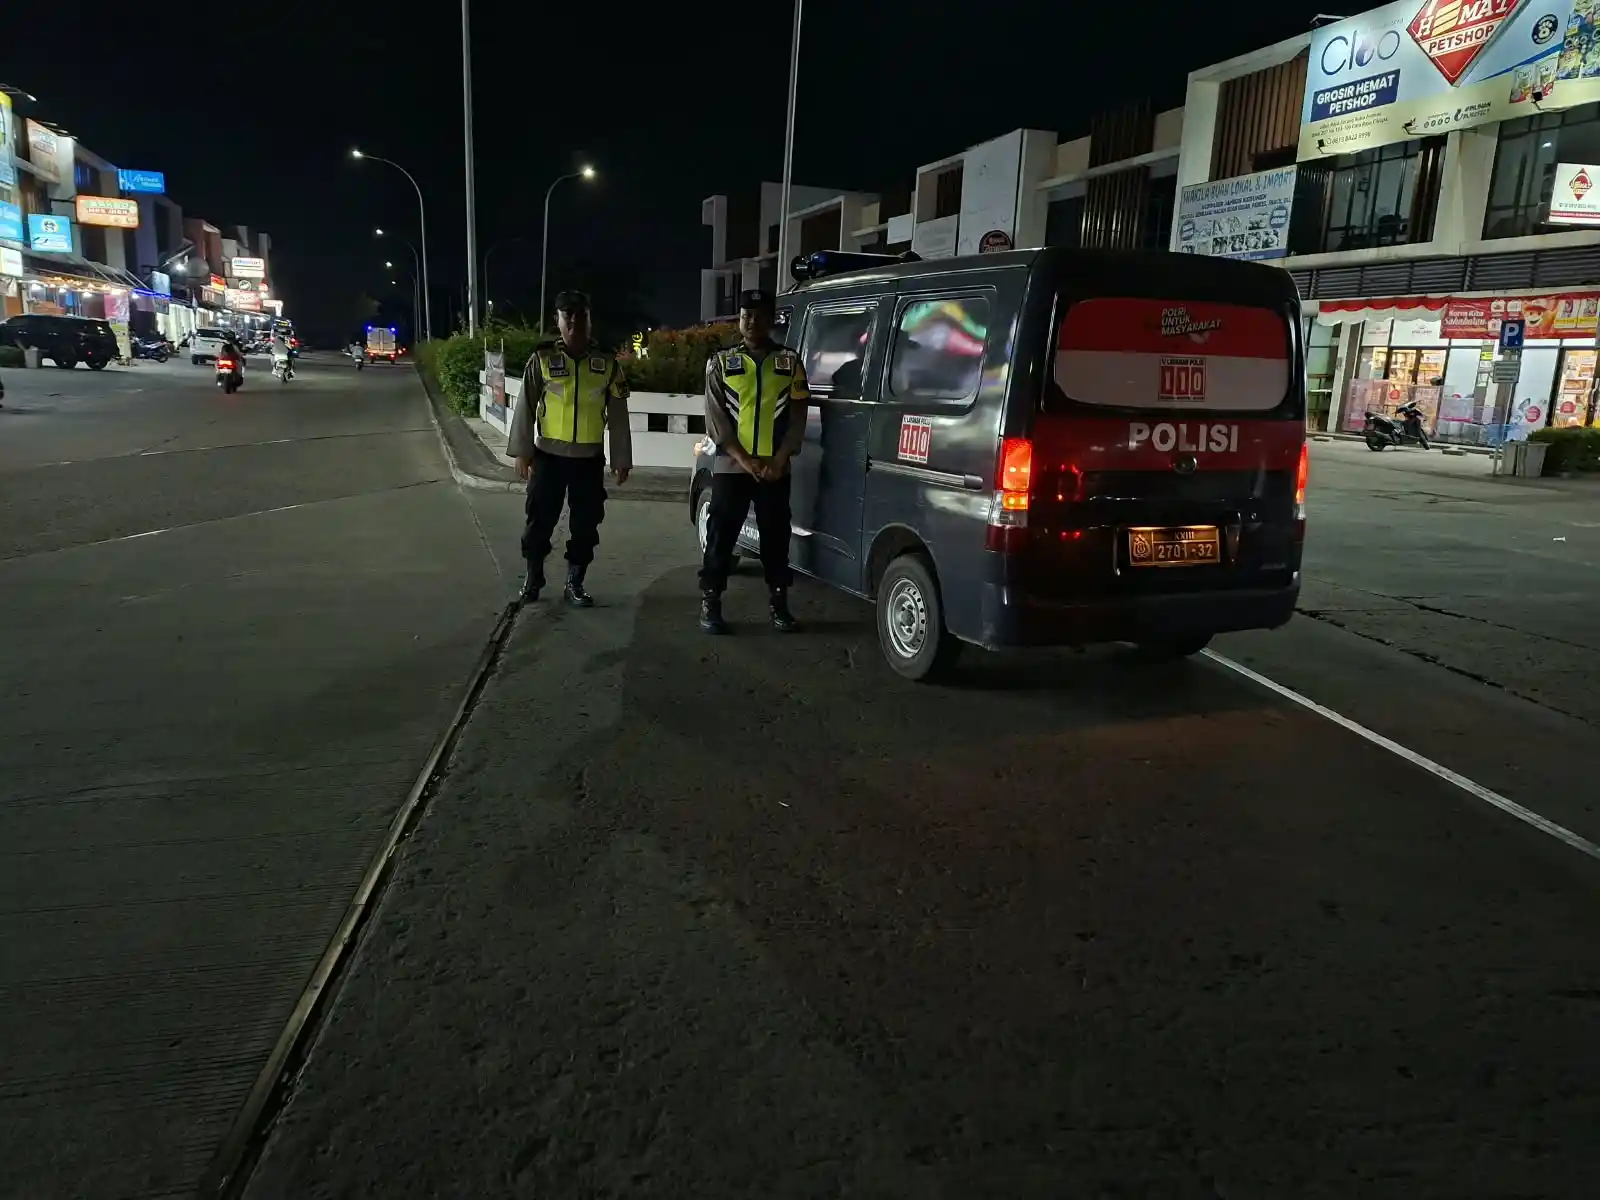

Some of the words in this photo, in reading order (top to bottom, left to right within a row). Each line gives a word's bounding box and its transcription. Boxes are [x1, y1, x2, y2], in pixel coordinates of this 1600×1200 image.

[1428, 25, 1495, 54] PETSHOP
[1316, 85, 1356, 105] GROSIR
[1356, 75, 1396, 94] HEMAT
[1329, 93, 1376, 114] PETSHOP
[1231, 179, 1253, 195] LOKAL
[1255, 177, 1262, 190] &
[1262, 169, 1295, 190] IMPORT
[1161, 307, 1187, 317] POLRI
[1161, 315, 1191, 326] UNTUK
[1161, 317, 1222, 336] MASYARAKAT
[1503, 322, 1519, 346] P
[1165, 371, 1202, 392] 110
[902, 429, 927, 453] 110
[1128, 422, 1238, 452] POLISI
